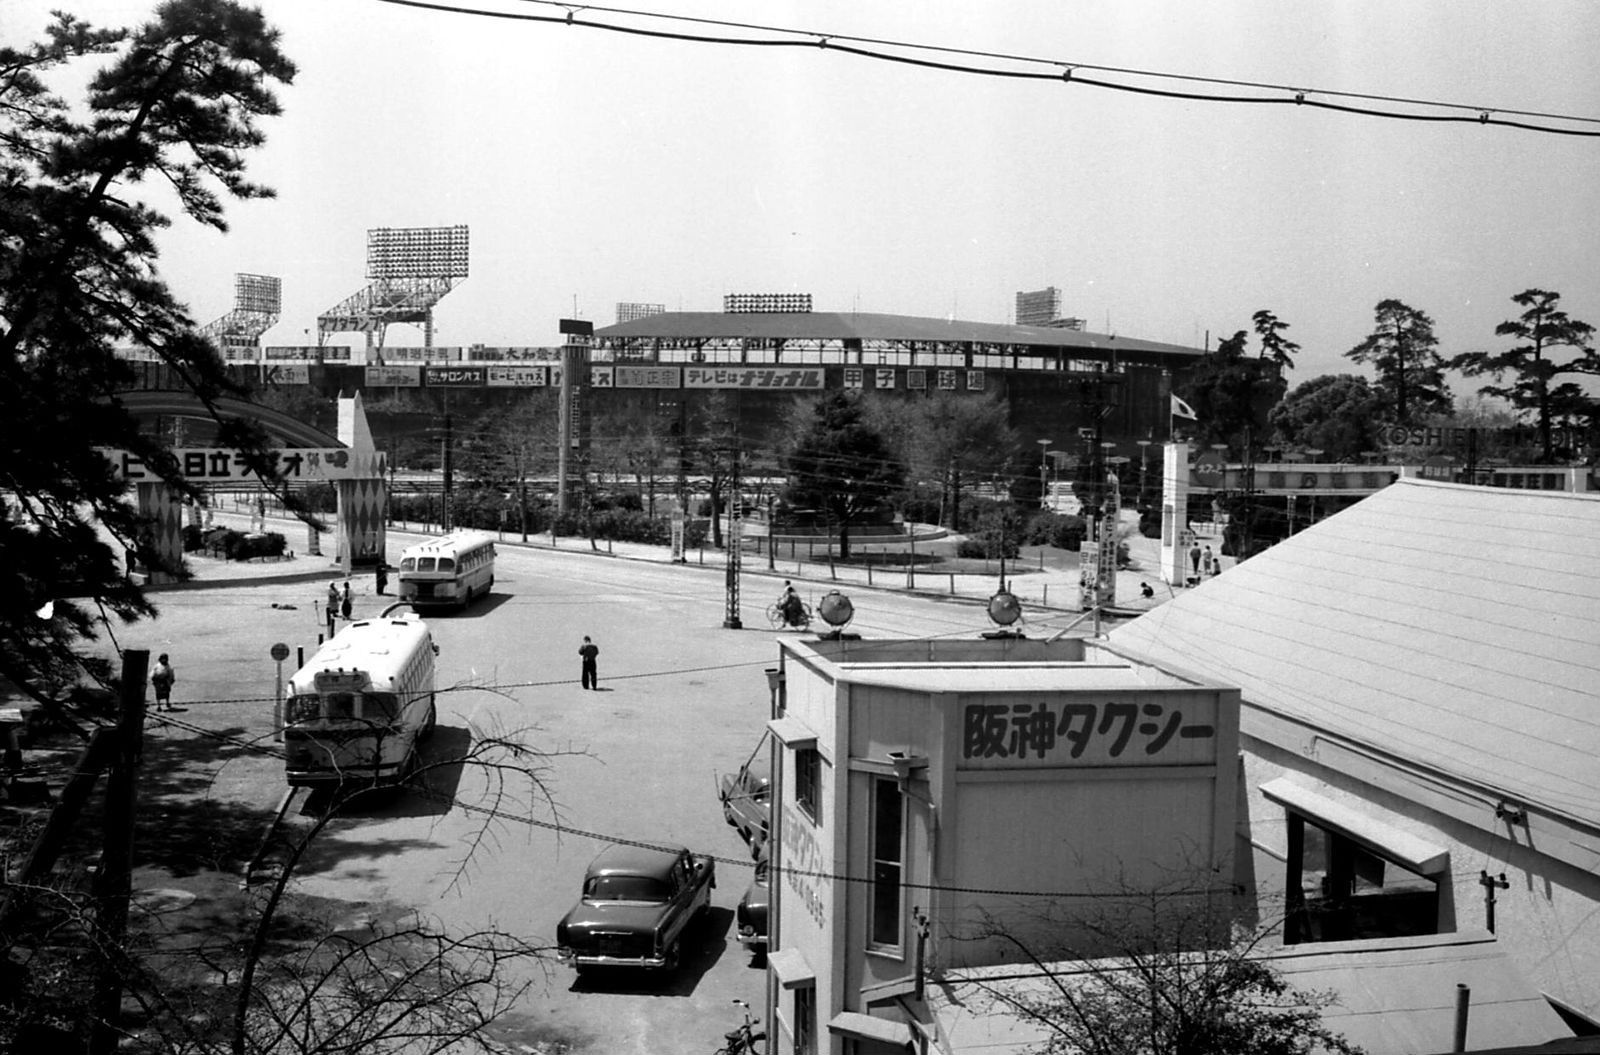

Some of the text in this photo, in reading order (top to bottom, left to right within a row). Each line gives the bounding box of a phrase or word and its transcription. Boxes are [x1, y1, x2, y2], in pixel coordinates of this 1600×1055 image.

[688, 369, 820, 388] テレビはナショナル
[963, 702, 1215, 759] 阪神タクシー
